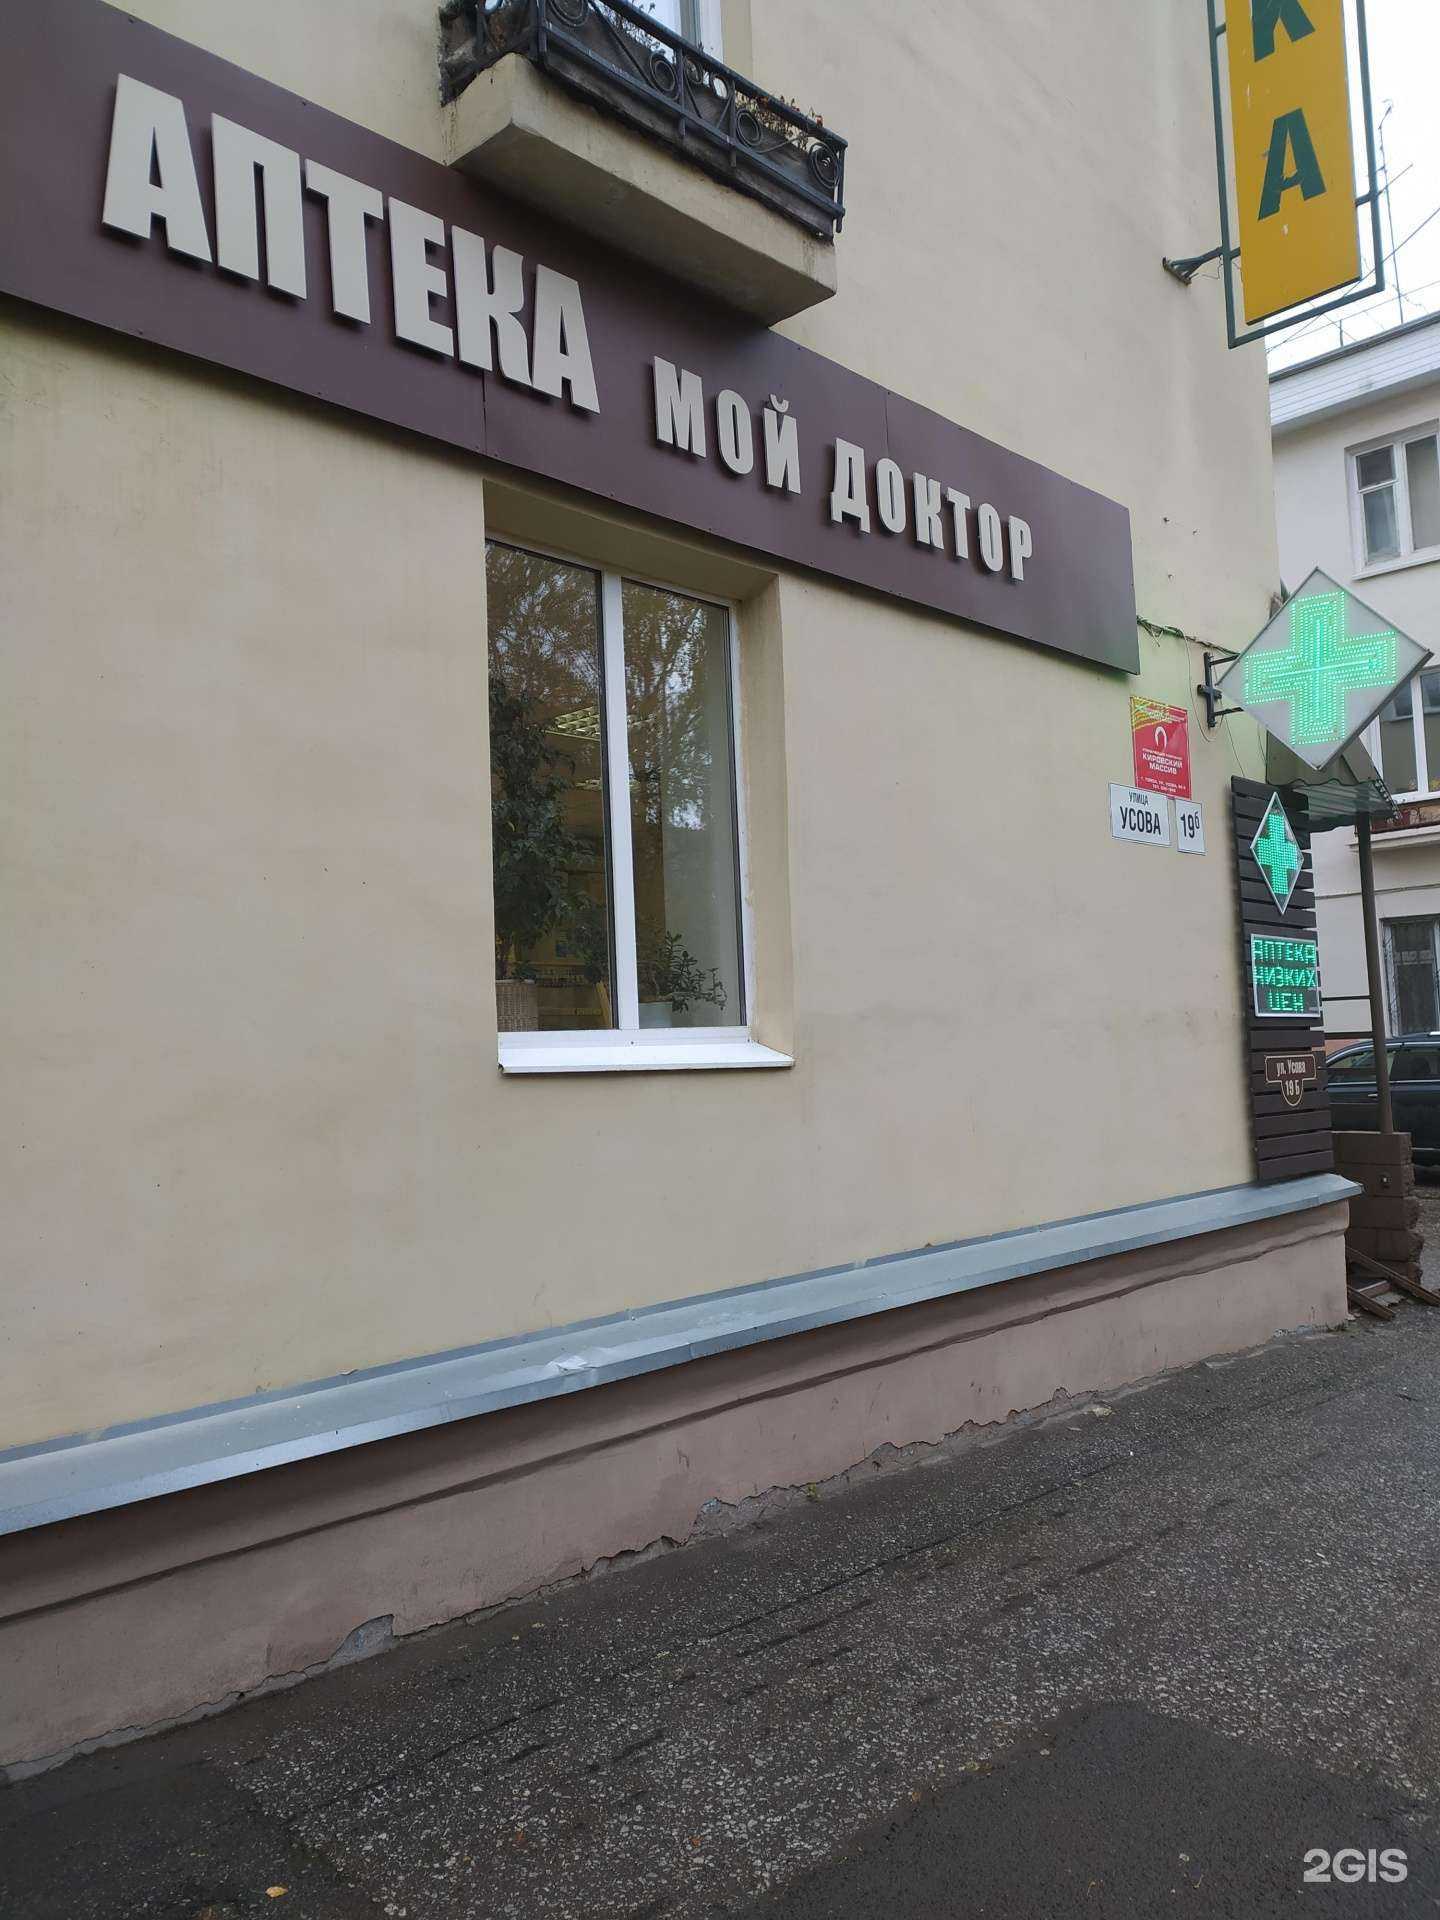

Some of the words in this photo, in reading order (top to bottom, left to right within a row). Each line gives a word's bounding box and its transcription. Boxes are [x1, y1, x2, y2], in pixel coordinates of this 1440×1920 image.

[102, 73, 600, 415] АПТЕКА
[652, 355, 802, 495] МОЙ
[830, 437, 1033, 582] ДОКТОР
[1149, 762, 1177, 775] МАССИВ
[1128, 791, 1149, 806] УЛИЦА
[1119, 805, 1162, 836] УСОВА
[1253, 940, 1316, 964] АПТЕКА
[1253, 965, 1317, 988] НИЗКИХ
[1268, 991, 1304, 1012] ЦЕН
[1287, 1059, 1306, 1074] Усова
